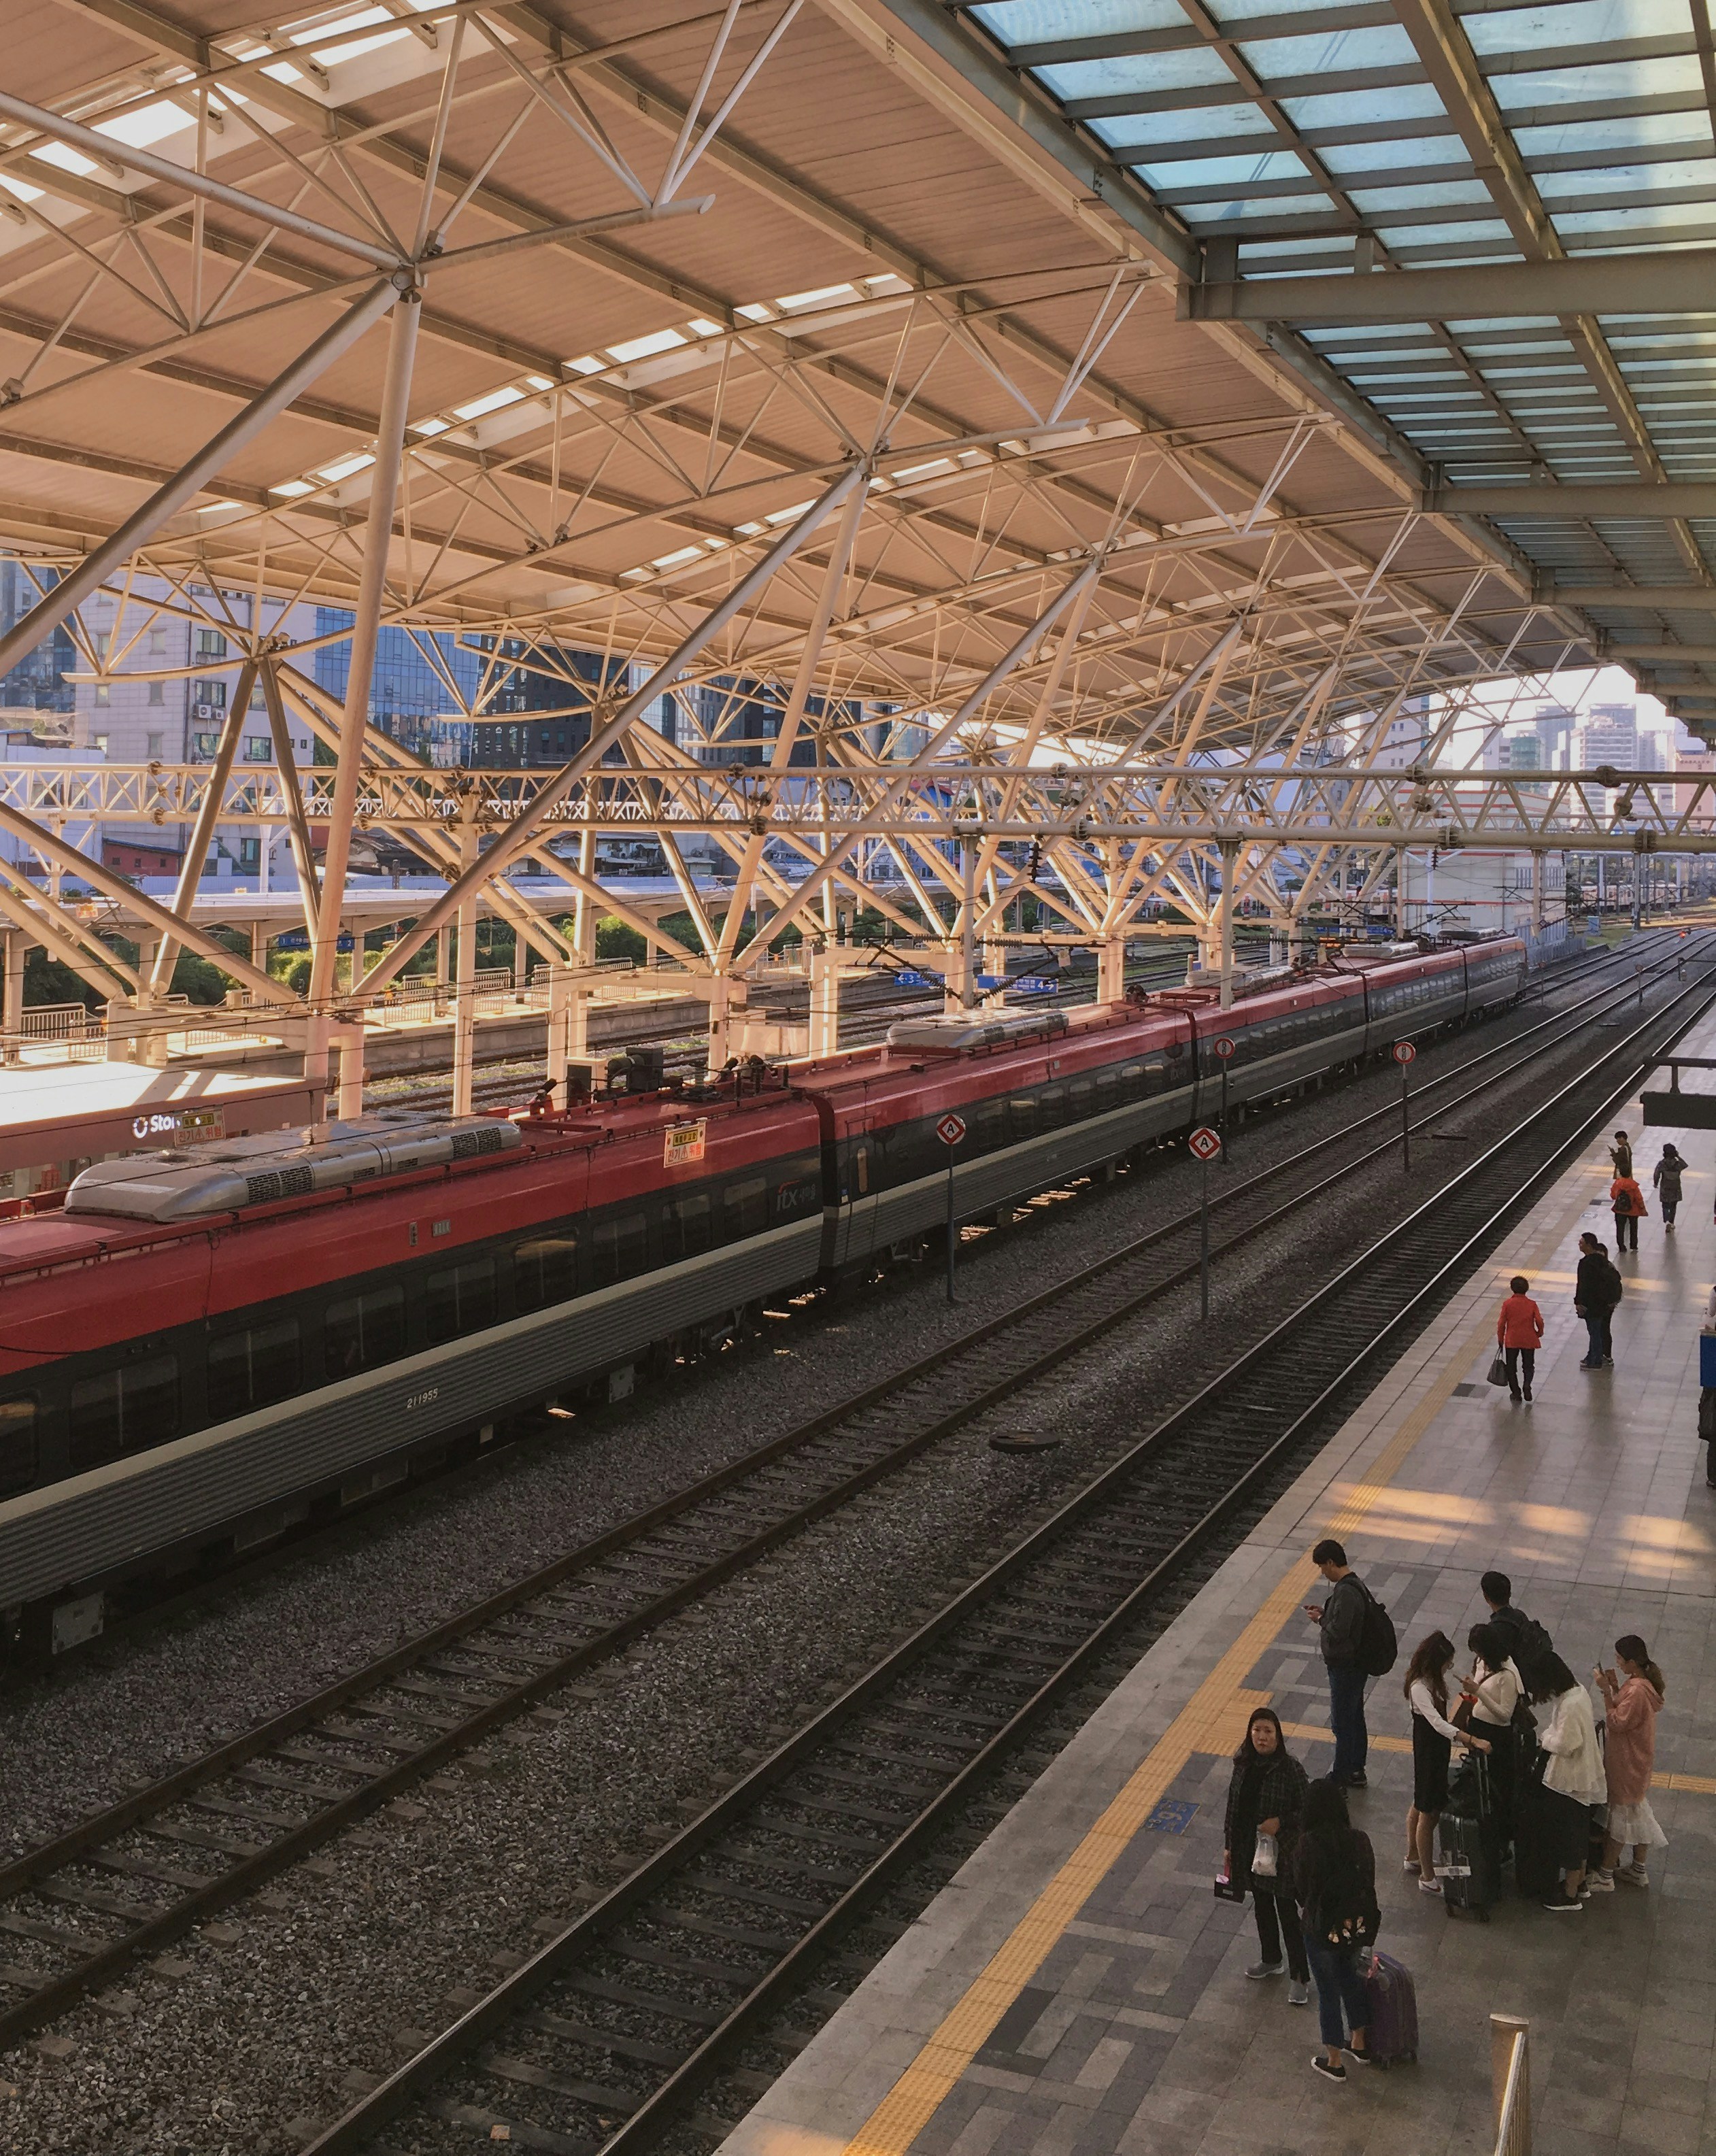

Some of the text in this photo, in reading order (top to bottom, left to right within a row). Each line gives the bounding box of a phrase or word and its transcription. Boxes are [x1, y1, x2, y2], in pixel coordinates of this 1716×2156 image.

[908, 975, 914, 983] 3
[1037, 981, 1044, 990] 4
[178, 1126, 222, 1143] 전기 위험
[947, 1124, 955, 1134] A
[1200, 1136, 1209, 1148] A
[668, 1143, 701, 1162] 전기 위험
[407, 1388, 439, 1409] 211955
